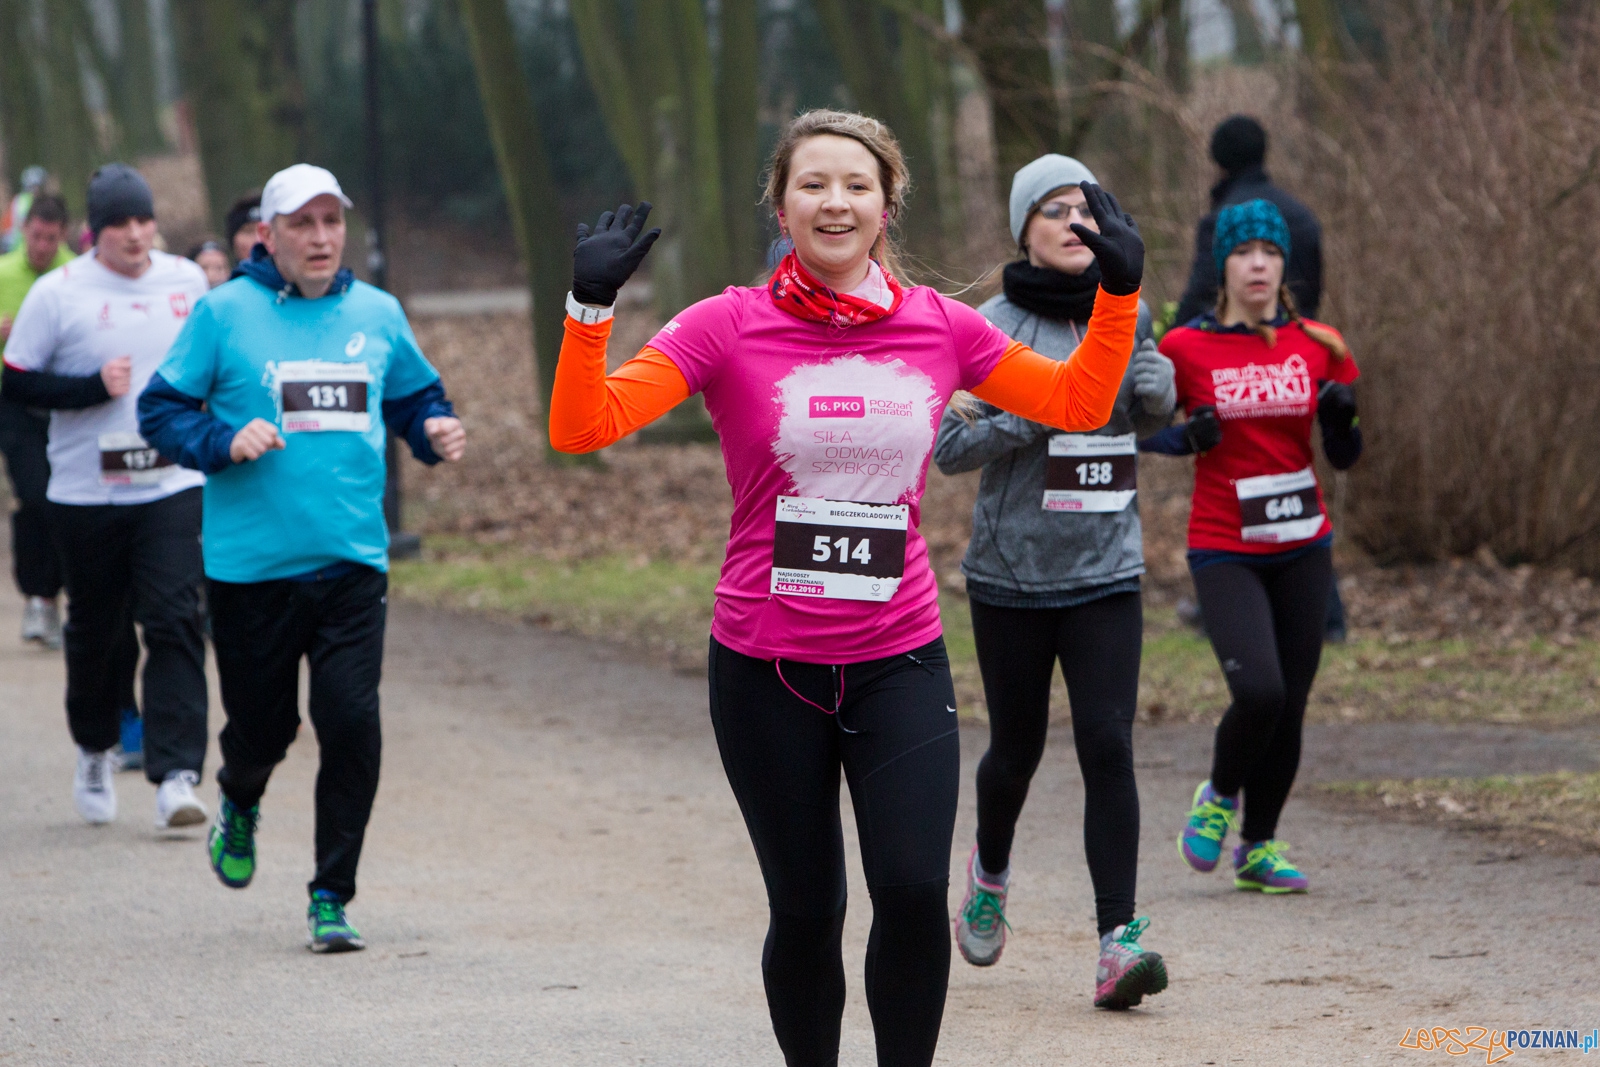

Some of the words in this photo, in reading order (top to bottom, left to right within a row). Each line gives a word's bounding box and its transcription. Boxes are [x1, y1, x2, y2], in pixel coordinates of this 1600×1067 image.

[307, 384, 348, 408] 131
[1214, 376, 1311, 409] SZPIKU
[813, 402, 831, 412] 16.
[833, 401, 861, 412] PKO
[869, 408, 913, 418] maraton
[813, 430, 853, 444] SIŁA
[121, 448, 159, 470] 157
[825, 446, 904, 462] ODWAGA
[811, 461, 902, 478] SZYBKOŚĆ
[1075, 461, 1113, 486] 138
[830, 510, 903, 520] BIEGCZEKOLADOWY.PL
[1264, 494, 1304, 521] 640
[812, 535, 872, 565] 514
[778, 584, 816, 593] 14.02.2016
